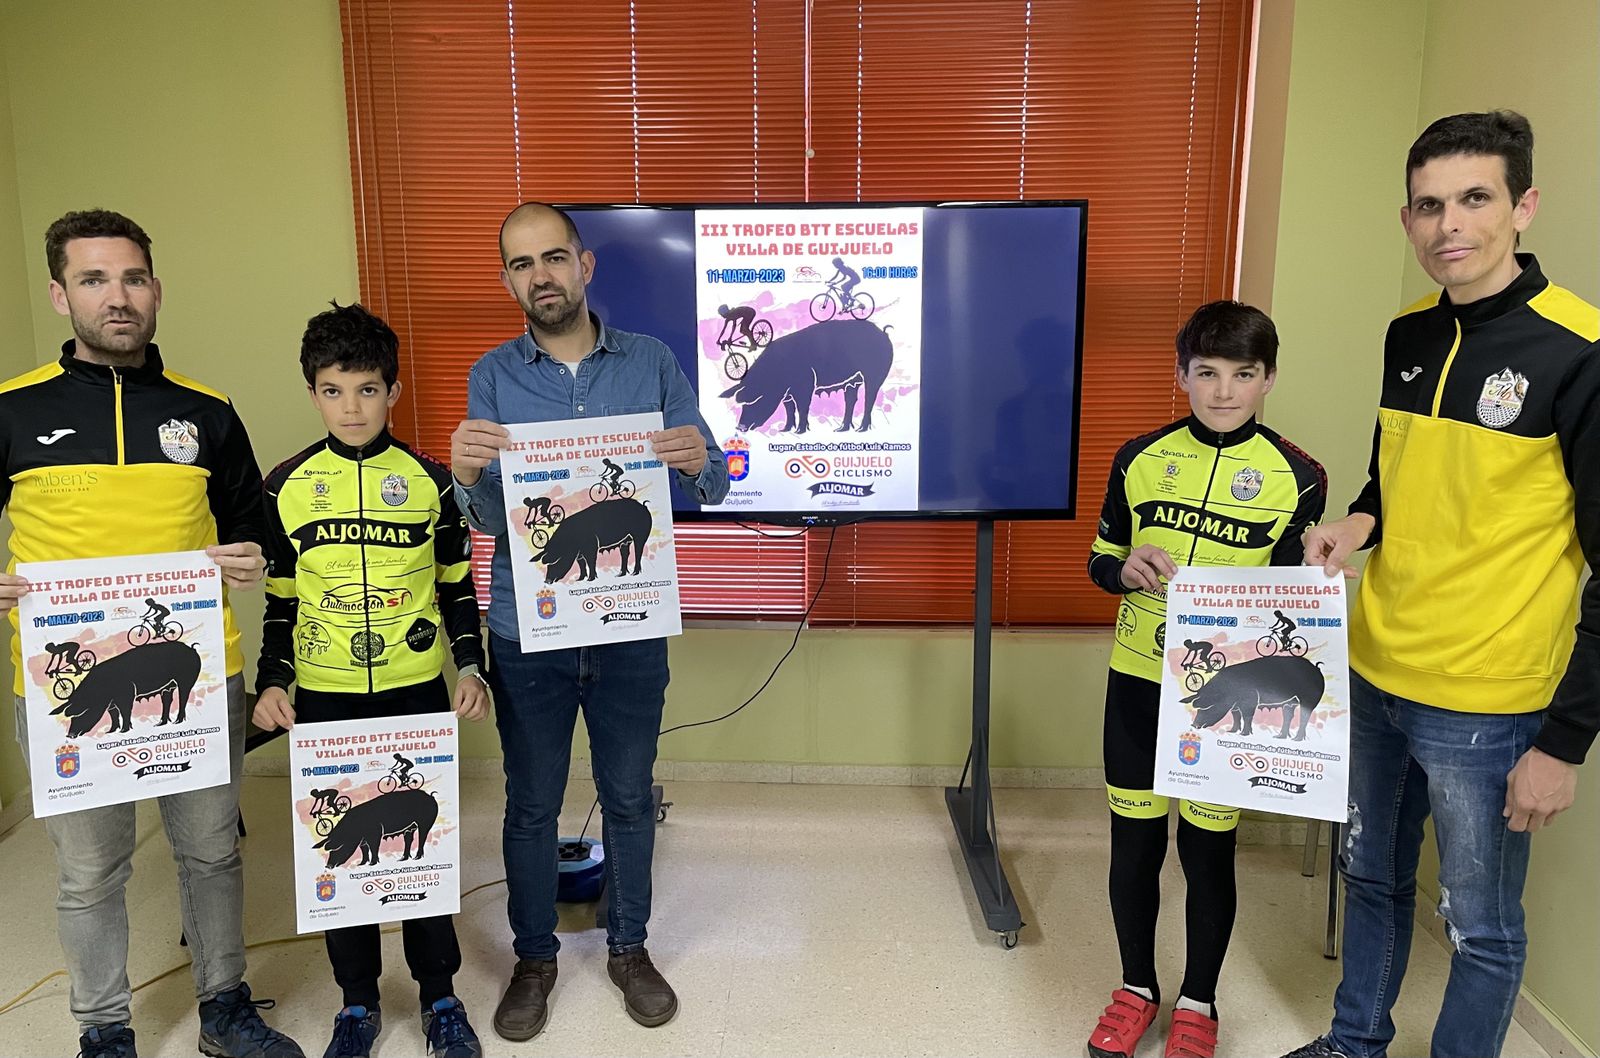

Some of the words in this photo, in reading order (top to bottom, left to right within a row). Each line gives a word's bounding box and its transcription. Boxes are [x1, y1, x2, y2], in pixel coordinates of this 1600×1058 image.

[701, 224, 728, 236] III
[733, 224, 795, 236] TROFEO
[801, 224, 830, 236] BTT
[836, 223, 918, 235] ESCUELAS
[726, 244, 778, 255] VILLA
[783, 243, 803, 255] DE
[808, 242, 893, 255] GUIJUELO
[706, 269, 785, 283] 11-MARZO-2023
[862, 267, 887, 278] 16:00
[889, 266, 918, 278] HORAS
[506, 442, 526, 452] II
[529, 438, 574, 450] TROFEO
[577, 436, 599, 446] BTT
[602, 430, 660, 443] ESCUELA
[769, 443, 794, 452] Lugar:
[795, 443, 826, 451] Estadio
[827, 443, 838, 451] de
[839, 443, 864, 451] fútbol
[865, 443, 882, 451] Luis
[883, 443, 911, 451] Ramos
[525, 452, 563, 463] VILLA
[566, 451, 581, 460] DE
[584, 444, 645, 458] GUIJUELO
[834, 457, 892, 467] GUIJUELO
[512, 469, 570, 484] 11-MARZO-2023
[819, 484, 864, 496] ALJOMAR
[1153, 505, 1249, 543] ALJOMAR
[316, 524, 411, 544] ALJOMAR
[26, 582, 51, 592] III
[55, 577, 112, 590] TROFEO
[116, 574, 142, 585] BTT
[146, 568, 215, 582] ESCUELAS
[651, 579, 672, 587] Ramos
[50, 592, 98, 605] VILLA
[102, 590, 120, 600] DE
[123, 583, 196, 598] GUIJUELO
[617, 590, 659, 602] GUIJUELO
[1175, 584, 1195, 593] III
[1200, 585, 1246, 594] TROFEO
[1250, 585, 1271, 595] BTT
[1275, 585, 1340, 595] ESCUELAS
[618, 599, 660, 609] CICLISMO
[1193, 598, 1233, 608] VILLA
[1237, 598, 1252, 608] DE
[1256, 599, 1319, 609] GUIJUELO
[33, 611, 105, 628] 11-MARZO-2023
[608, 611, 641, 623] ALJOMAR
[1177, 614, 1238, 627] 11-MARZO-2023
[121, 736, 148, 746] Estadio
[159, 732, 180, 740] fútbol
[181, 729, 196, 737] Luis
[196, 726, 220, 735] Ramos
[298, 739, 317, 748] III
[321, 735, 366, 746] TROFEO
[370, 733, 391, 742] BTT
[395, 728, 453, 740] ESCUELAS
[155, 738, 205, 754] GUIJUELO
[316, 748, 354, 758] VILLA
[358, 747, 372, 755] DE
[376, 741, 436, 753] GUIJUELO
[1240, 743, 1266, 752] Estadio
[1277, 747, 1298, 756] fútbol
[1299, 750, 1314, 758] Luis
[1315, 752, 1341, 761] Ramos
[156, 748, 206, 761] CICLISMO
[143, 762, 183, 777] ALJOMAR
[1272, 758, 1324, 772] GUIJUELO
[1272, 767, 1324, 780] CICLISMO
[1258, 777, 1298, 792] ALJOMAR
[1110, 793, 1152, 807] MAGLIA
[1188, 804, 1234, 822] MAGLIA
[398, 873, 440, 884] GUIJUELO
[398, 881, 440, 890] CICLISMO
[387, 892, 420, 904] ALJOMAR
